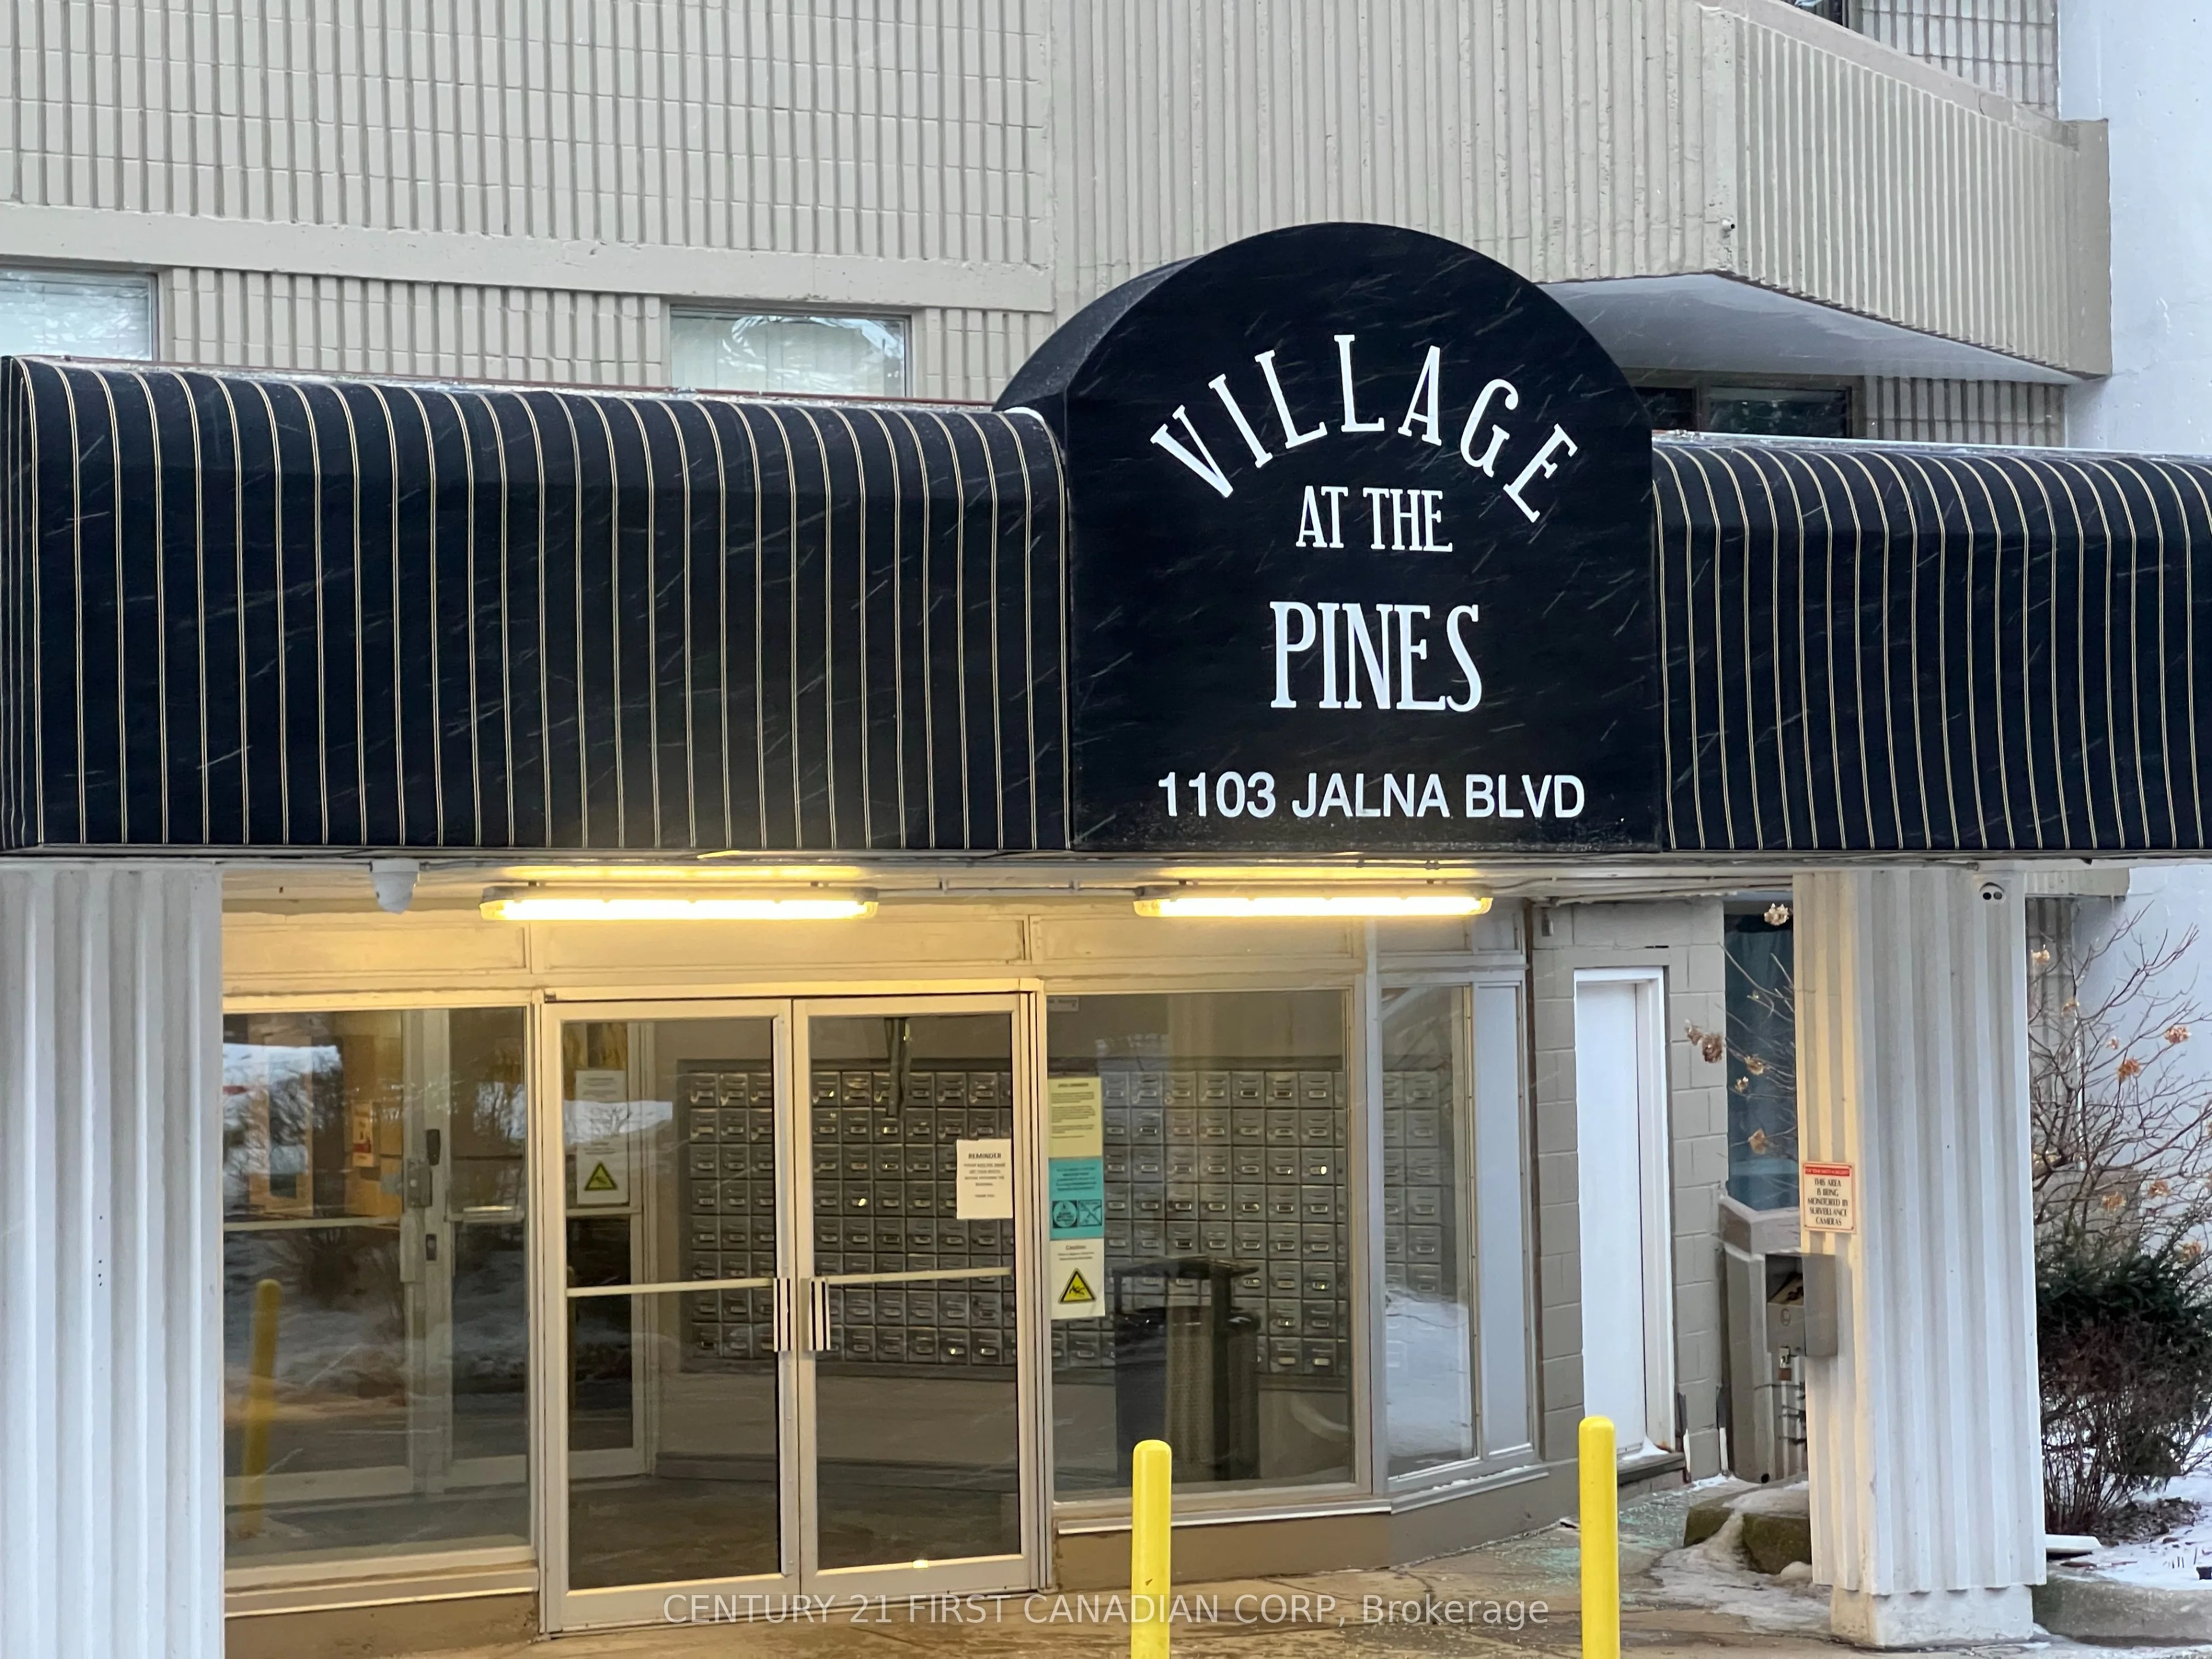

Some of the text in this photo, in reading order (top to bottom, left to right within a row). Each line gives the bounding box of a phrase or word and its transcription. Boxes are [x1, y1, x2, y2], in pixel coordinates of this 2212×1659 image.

[1150, 334, 1578, 523] VILLAGE
[1296, 486, 1453, 552] AT THE
[1270, 601, 1482, 712] PINES
[1158, 771, 1585, 818] 1103 JALNA BLVD
[1815, 1177, 1841, 1187] THIS AREA
[1823, 1188, 1839, 1196] BEING
[1808, 1198, 1840, 1206] MONITORED
[1809, 1207, 1847, 1216] SURVEILLANCE
[1816, 1217, 1842, 1226] CAMERAS
